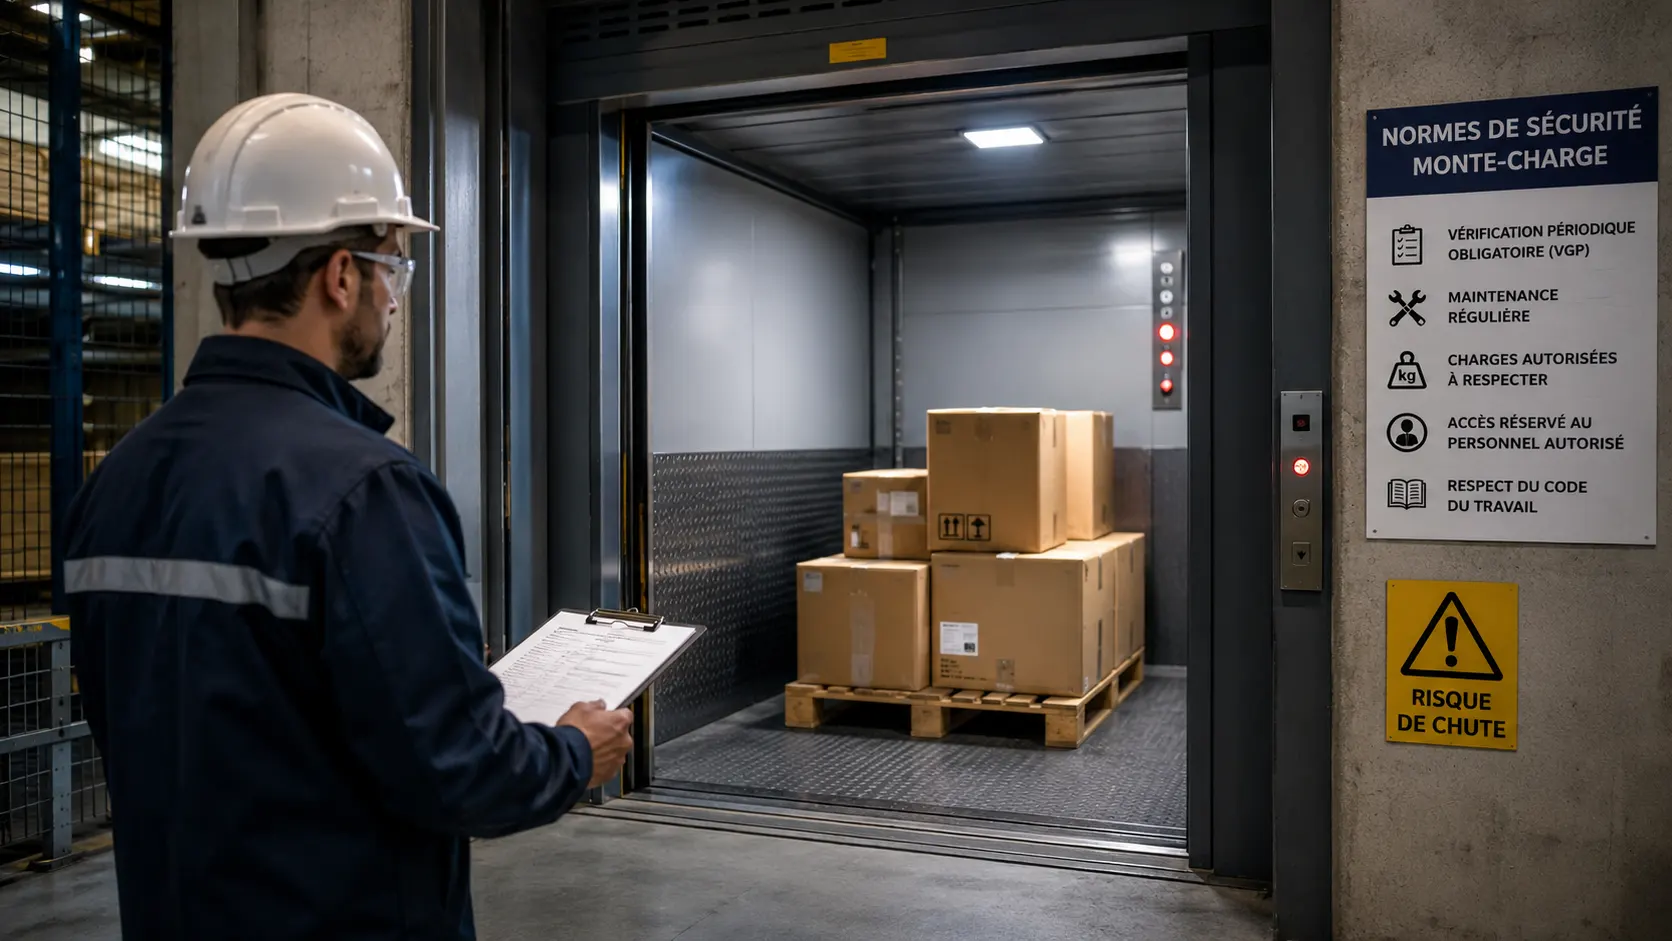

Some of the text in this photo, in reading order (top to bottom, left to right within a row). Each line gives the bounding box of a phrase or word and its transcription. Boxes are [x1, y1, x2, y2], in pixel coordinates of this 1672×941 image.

[1382, 104, 1642, 147] NORMES DE SÉCURITÉ
[1413, 145, 1608, 176] MONTE-CHARGE
[1448, 221, 1636, 241] VÉRIFICATION PÉRIODIQUE
[1448, 244, 1590, 261] OBLIGATOIRE (VGP)
[1448, 289, 1559, 304] MAINTENANCE
[1448, 308, 1530, 323] RÉGULIÈRE
[1447, 349, 1618, 366] CHARGES AUTORISÉES
[1398, 369, 1416, 384] kg
[1447, 372, 1548, 387] À RESPECTER
[1447, 414, 1592, 429] ACCÈS RÉSERVÉ AU
[1448, 434, 1624, 450] PERSONNEL AUTORISÉ
[1448, 480, 1588, 494] RESPECT DU CODE
[1448, 500, 1538, 514] DU TRAVAIL
[1412, 688, 1491, 710] RISQUE
[1398, 714, 1506, 738] DE CHUTE
